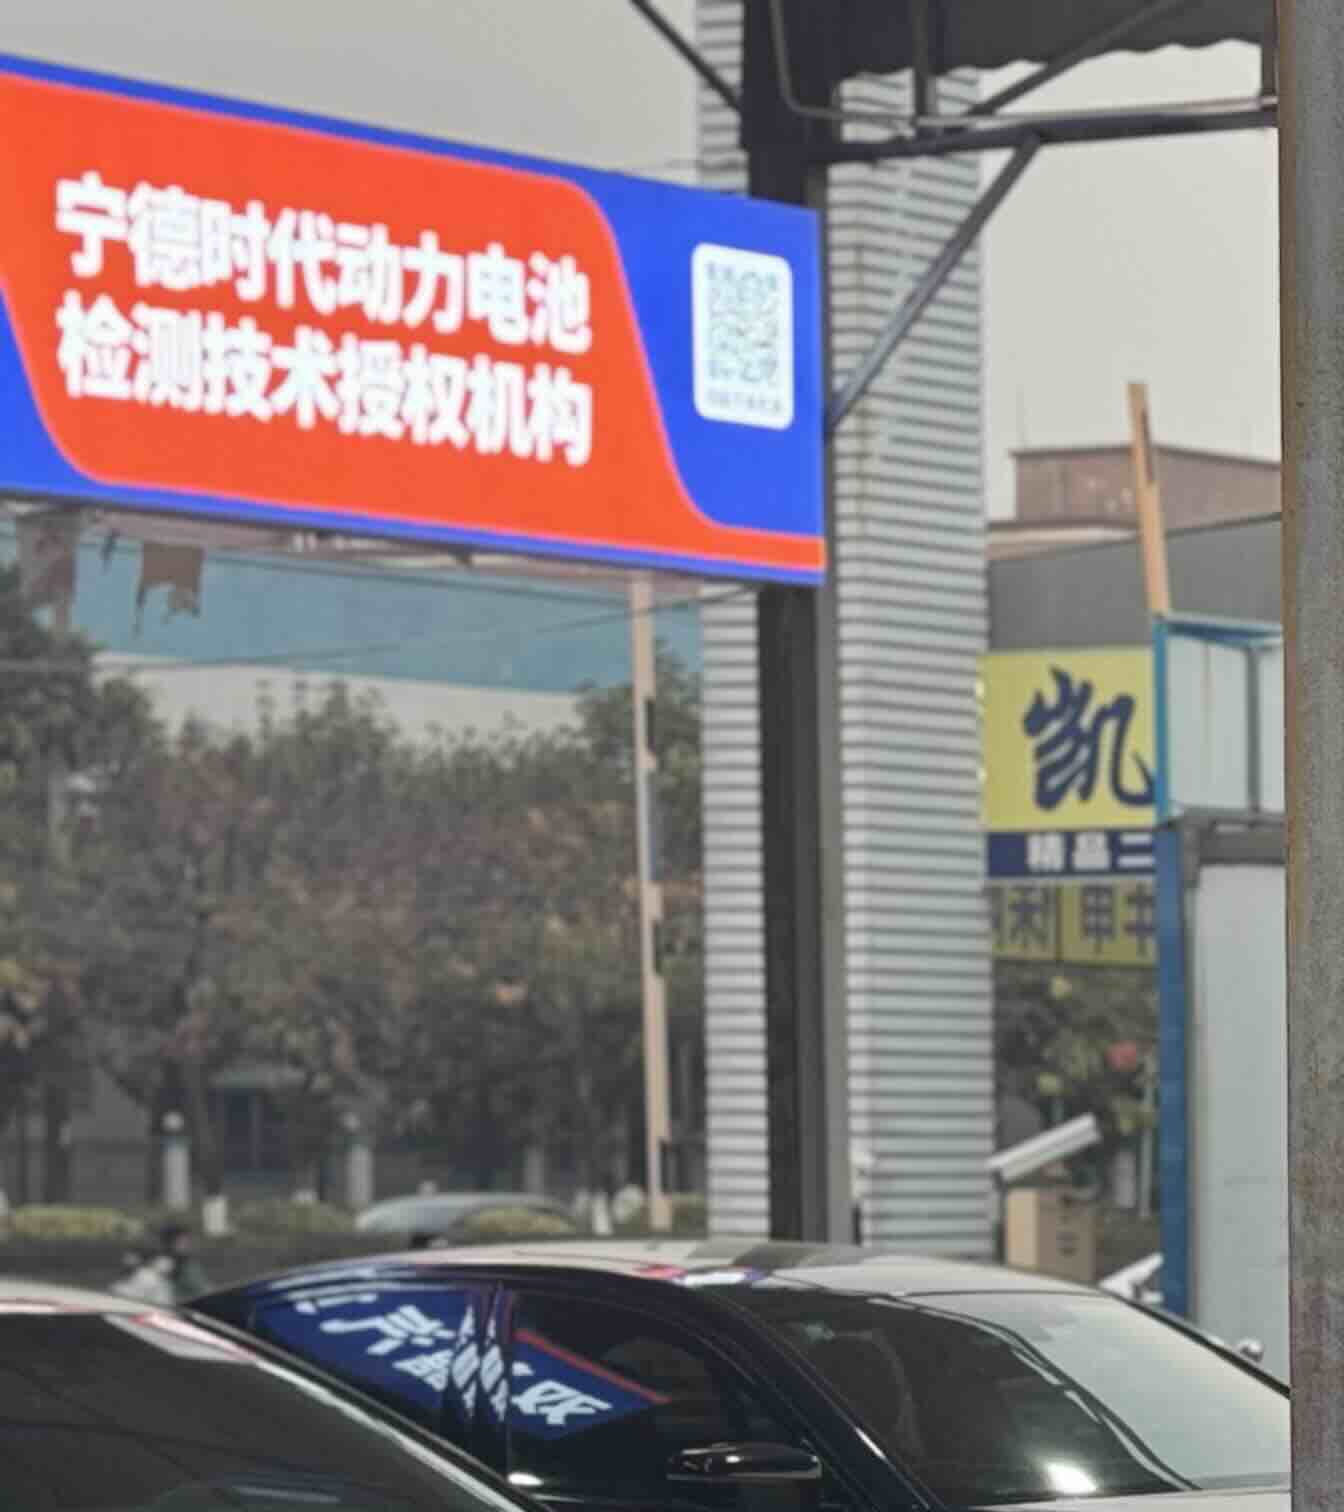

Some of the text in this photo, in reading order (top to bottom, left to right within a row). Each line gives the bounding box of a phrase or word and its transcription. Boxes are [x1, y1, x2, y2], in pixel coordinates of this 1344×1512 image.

[56, 172, 591, 353] 宁德时代动力电池
[56, 291, 592, 466] 检测技术授权机构
[1023, 663, 1155, 811] 凯
